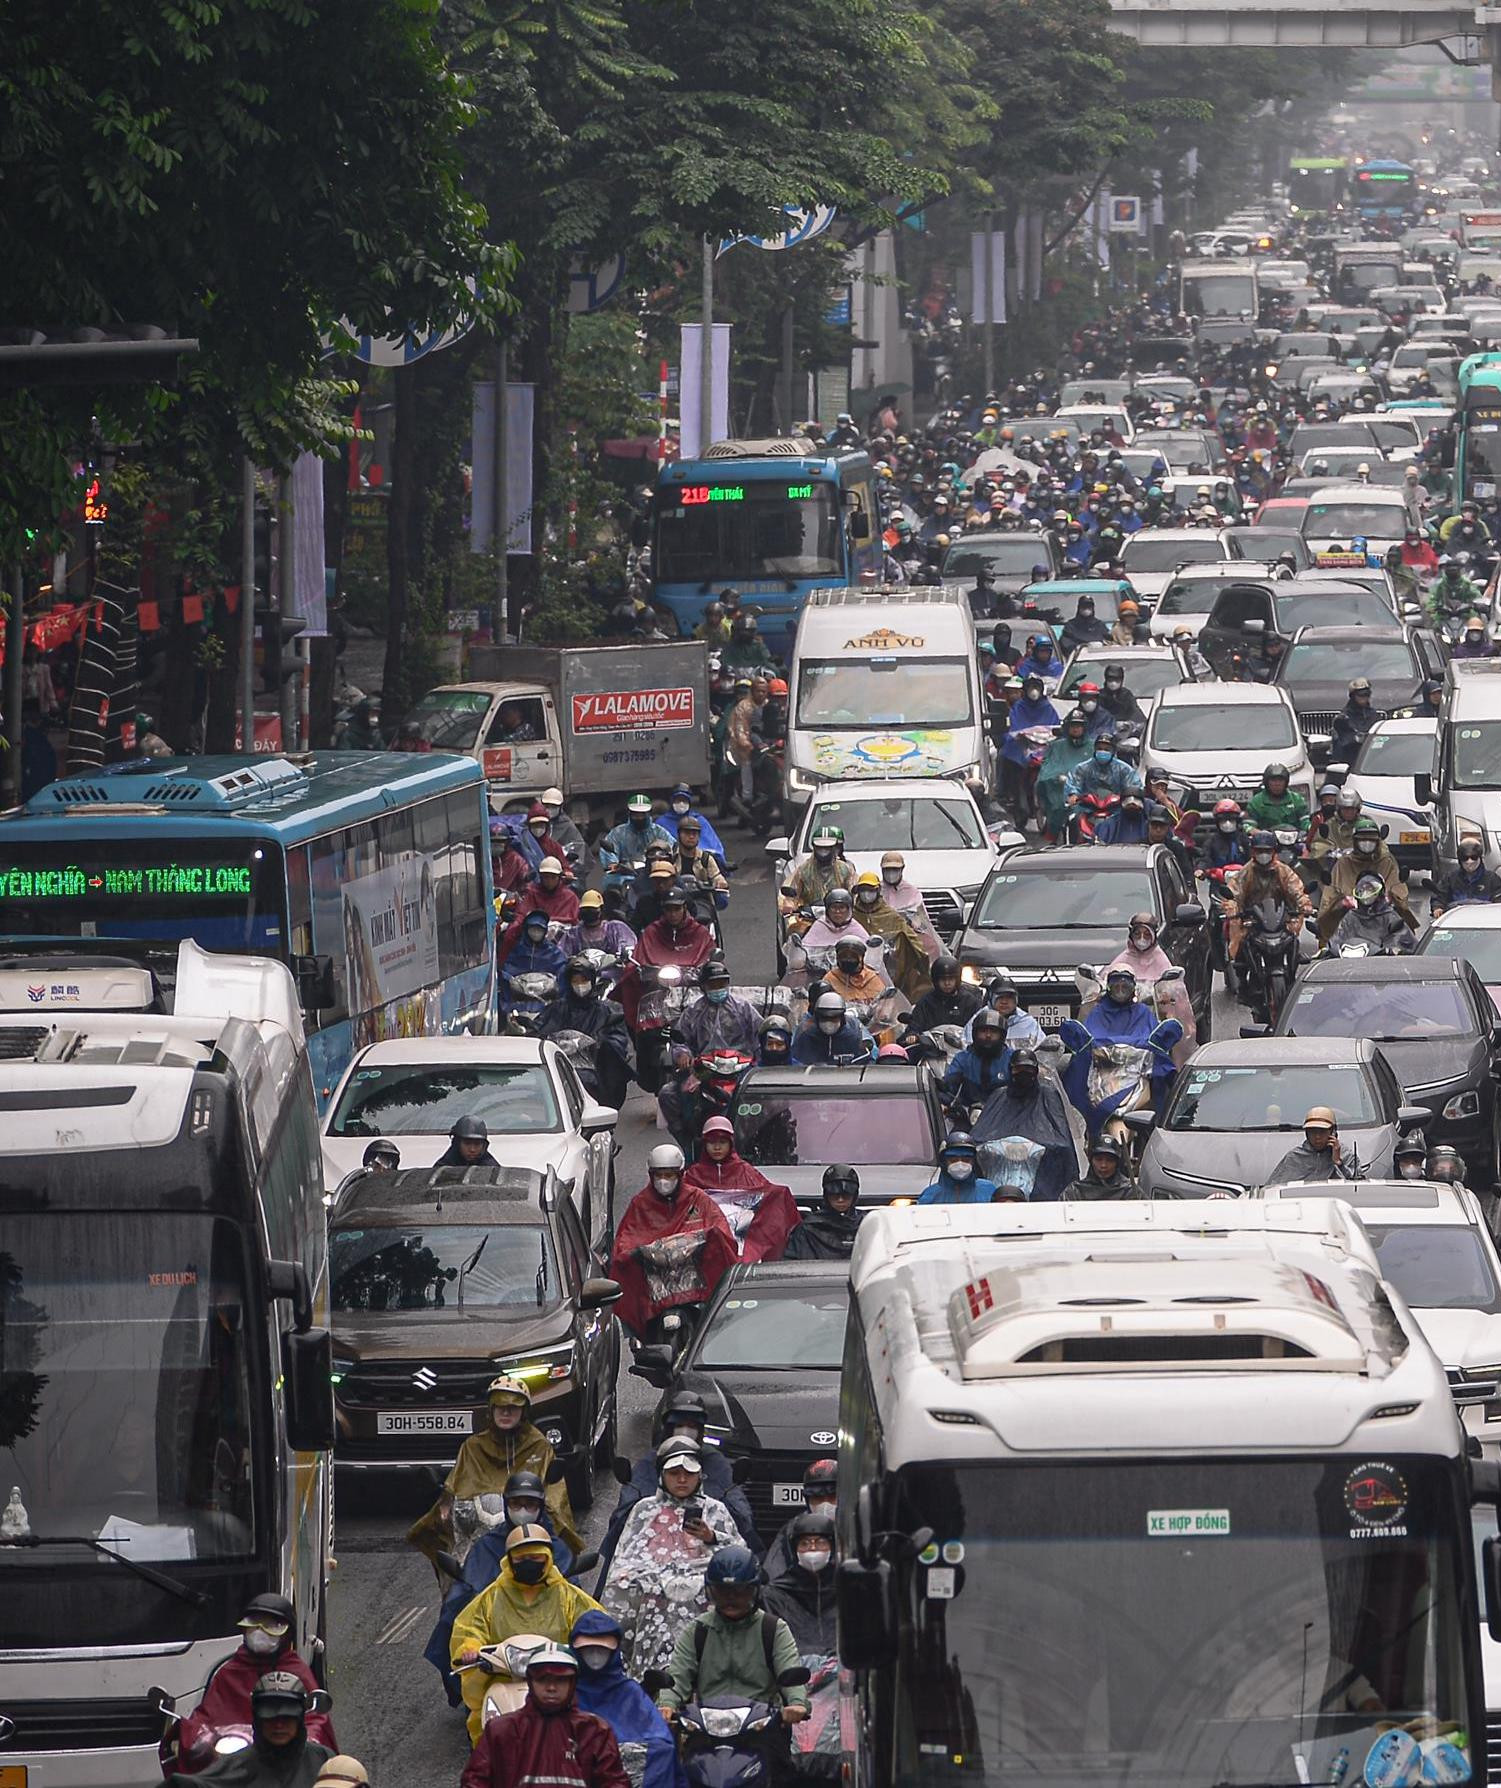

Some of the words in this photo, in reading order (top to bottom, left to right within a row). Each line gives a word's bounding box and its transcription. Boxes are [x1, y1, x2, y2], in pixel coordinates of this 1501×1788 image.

[843, 638, 888, 650] ANH
[896, 635, 925, 648] VŨ
[594, 692, 691, 716] LALAMOVE
[35, 865, 86, 896] NGHĨA
[105, 869, 142, 893] NAM
[144, 863, 202, 893] THĂNG
[205, 867, 250, 893] LONG
[1040, 1006, 1059, 1016] 30G
[385, 1417, 465, 1430] 30H-558.84
[1151, 1516, 1166, 1531] XE
[1168, 1515, 1192, 1533] HỢP
[1195, 1511, 1228, 1530] ĐỒNG
